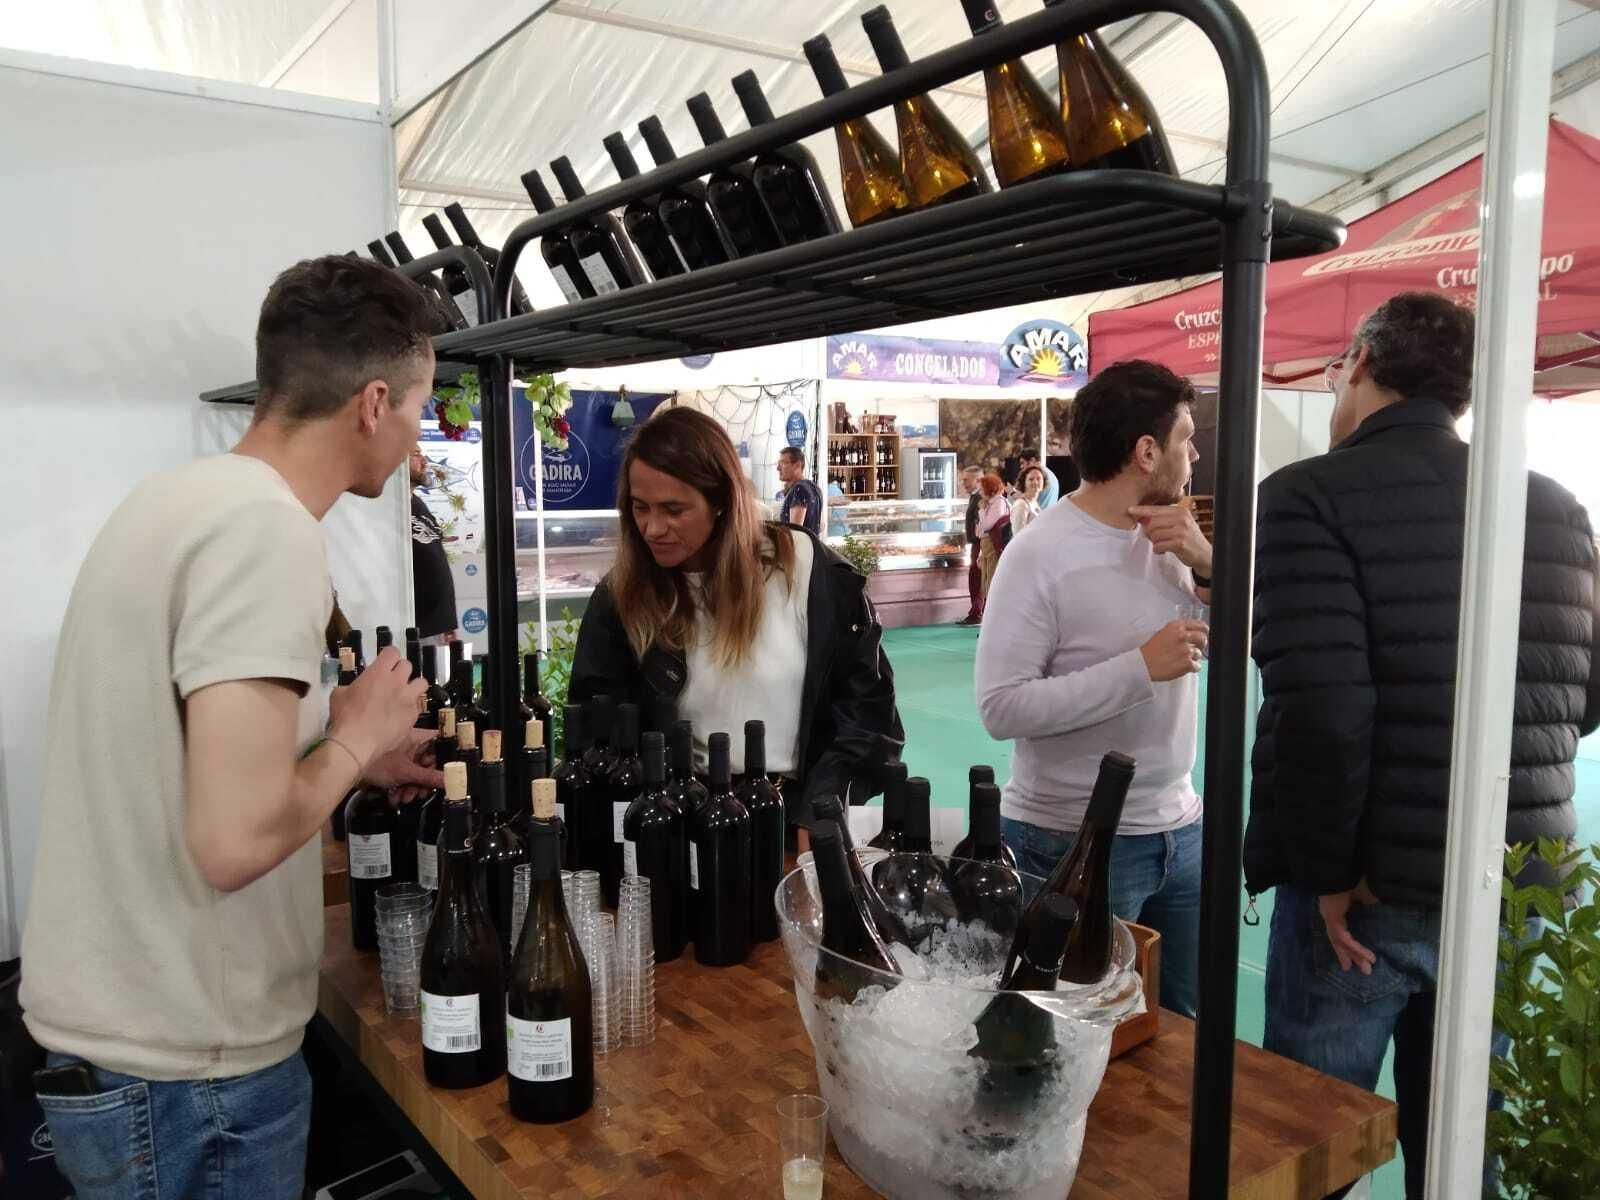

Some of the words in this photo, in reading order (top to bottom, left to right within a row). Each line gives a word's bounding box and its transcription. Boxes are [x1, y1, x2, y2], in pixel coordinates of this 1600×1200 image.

[1437, 251, 1575, 289] Crupo
[832, 340, 877, 369] AMAR
[895, 352, 987, 379] CONGELADOS
[1010, 328, 1087, 370] AMAR
